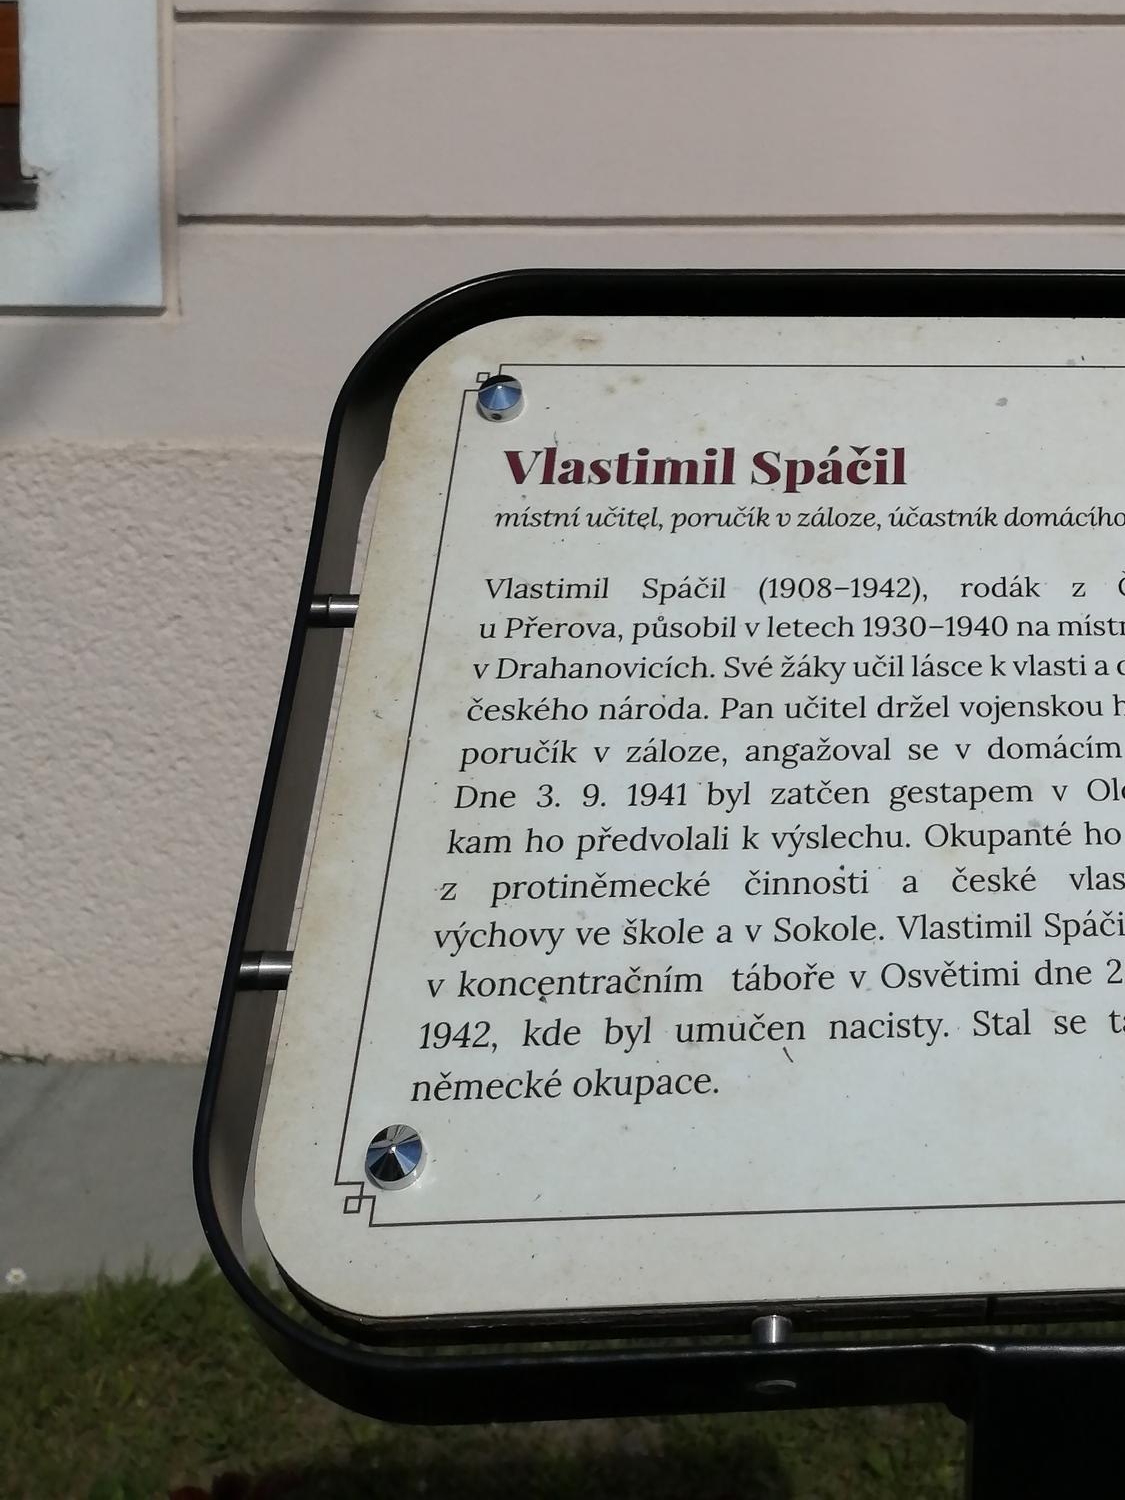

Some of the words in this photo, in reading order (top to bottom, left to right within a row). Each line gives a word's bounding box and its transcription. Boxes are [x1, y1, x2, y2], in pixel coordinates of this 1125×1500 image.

[504, 447, 736, 485] Vlastimil
[751, 445, 907, 493] Spáčil
[495, 507, 580, 527] místní
[586, 507, 663, 531] učitel,
[670, 506, 770, 534] poručík
[776, 513, 791, 527] v
[797, 507, 881, 531] záloze,
[888, 506, 998, 527] účastník
[485, 577, 608, 599] Vlastimil
[643, 576, 725, 605] Spáčil
[961, 575, 1040, 598] rodák
[1072, 583, 1086, 597] z
[480, 623, 496, 638] u
[504, 616, 622, 642] Přerova,
[632, 616, 735, 645] působil
[745, 622, 760, 637] v
[767, 616, 854, 637] letech
[1017, 621, 1050, 636] na
[473, 664, 490, 679] v
[496, 656, 715, 679] Drahanovicích.
[724, 655, 773, 678] Své
[780, 654, 846, 684] žáky
[853, 655, 904, 677] učil
[912, 653, 982, 677] lásce
[990, 654, 1006, 676] k
[1013, 654, 1087, 676] vlasti
[1095, 660, 1110, 676] a
[467, 697, 588, 721] českého
[599, 695, 708, 720] národa.
[720, 698, 774, 719] Pan
[784, 695, 866, 718] učitel
[877, 695, 949, 718] držel
[960, 694, 1103, 725] vojenskou
[459, 740, 577, 772] poručík
[594, 747, 610, 763] v
[626, 738, 727, 767] záloze,
[746, 737, 890, 769] angažoval
[909, 744, 938, 760] se
[955, 744, 971, 759] v
[988, 734, 1122, 759] domácím
[454, 786, 516, 808] Dne
[537, 784, 560, 808] 3.
[583, 784, 605, 807] 9.
[628, 783, 686, 806] 1941
[708, 781, 750, 813] byl
[771, 780, 869, 805] zatčen
[890, 783, 1033, 811] gestapem
[1052, 785, 1068, 801] v
[447, 829, 511, 854] kam
[525, 828, 564, 852] ho
[576, 826, 728, 860] předvolali
[742, 825, 759, 850] k
[771, 824, 910, 857] výslechu.
[925, 821, 1071, 854] Okupanté
[1084, 821, 1121, 845] ho
[440, 883, 457, 900] z
[490, 870, 710, 908] protiněmecké
[745, 871, 869, 896] činnosti
[903, 876, 918, 893] a
[952, 866, 1036, 892] české
[434, 921, 565, 957] výchovy
[576, 927, 610, 945] ve
[623, 918, 704, 945] škole
[716, 925, 733, 943] a
[745, 925, 762, 942] v
[774, 915, 884, 942] Sokole.
[896, 912, 1032, 939] Vlastimil
[427, 979, 445, 998] v
[457, 966, 703, 997] koncentračním
[732, 963, 834, 991] táboře
[849, 971, 867, 988] v
[881, 960, 1020, 988] Osvětimi
[1035, 959, 1092, 985] dne
[420, 1021, 497, 1053] 1942,
[522, 1018, 581, 1046] kde
[605, 1016, 651, 1053] byl
[675, 1013, 805, 1043] umučen
[829, 1012, 948, 1046] nacisty.
[973, 1008, 1031, 1036] Stal
[1054, 1015, 1086, 1035] se
[410, 1069, 562, 1101] německé
[573, 1068, 718, 1105] okupace.
